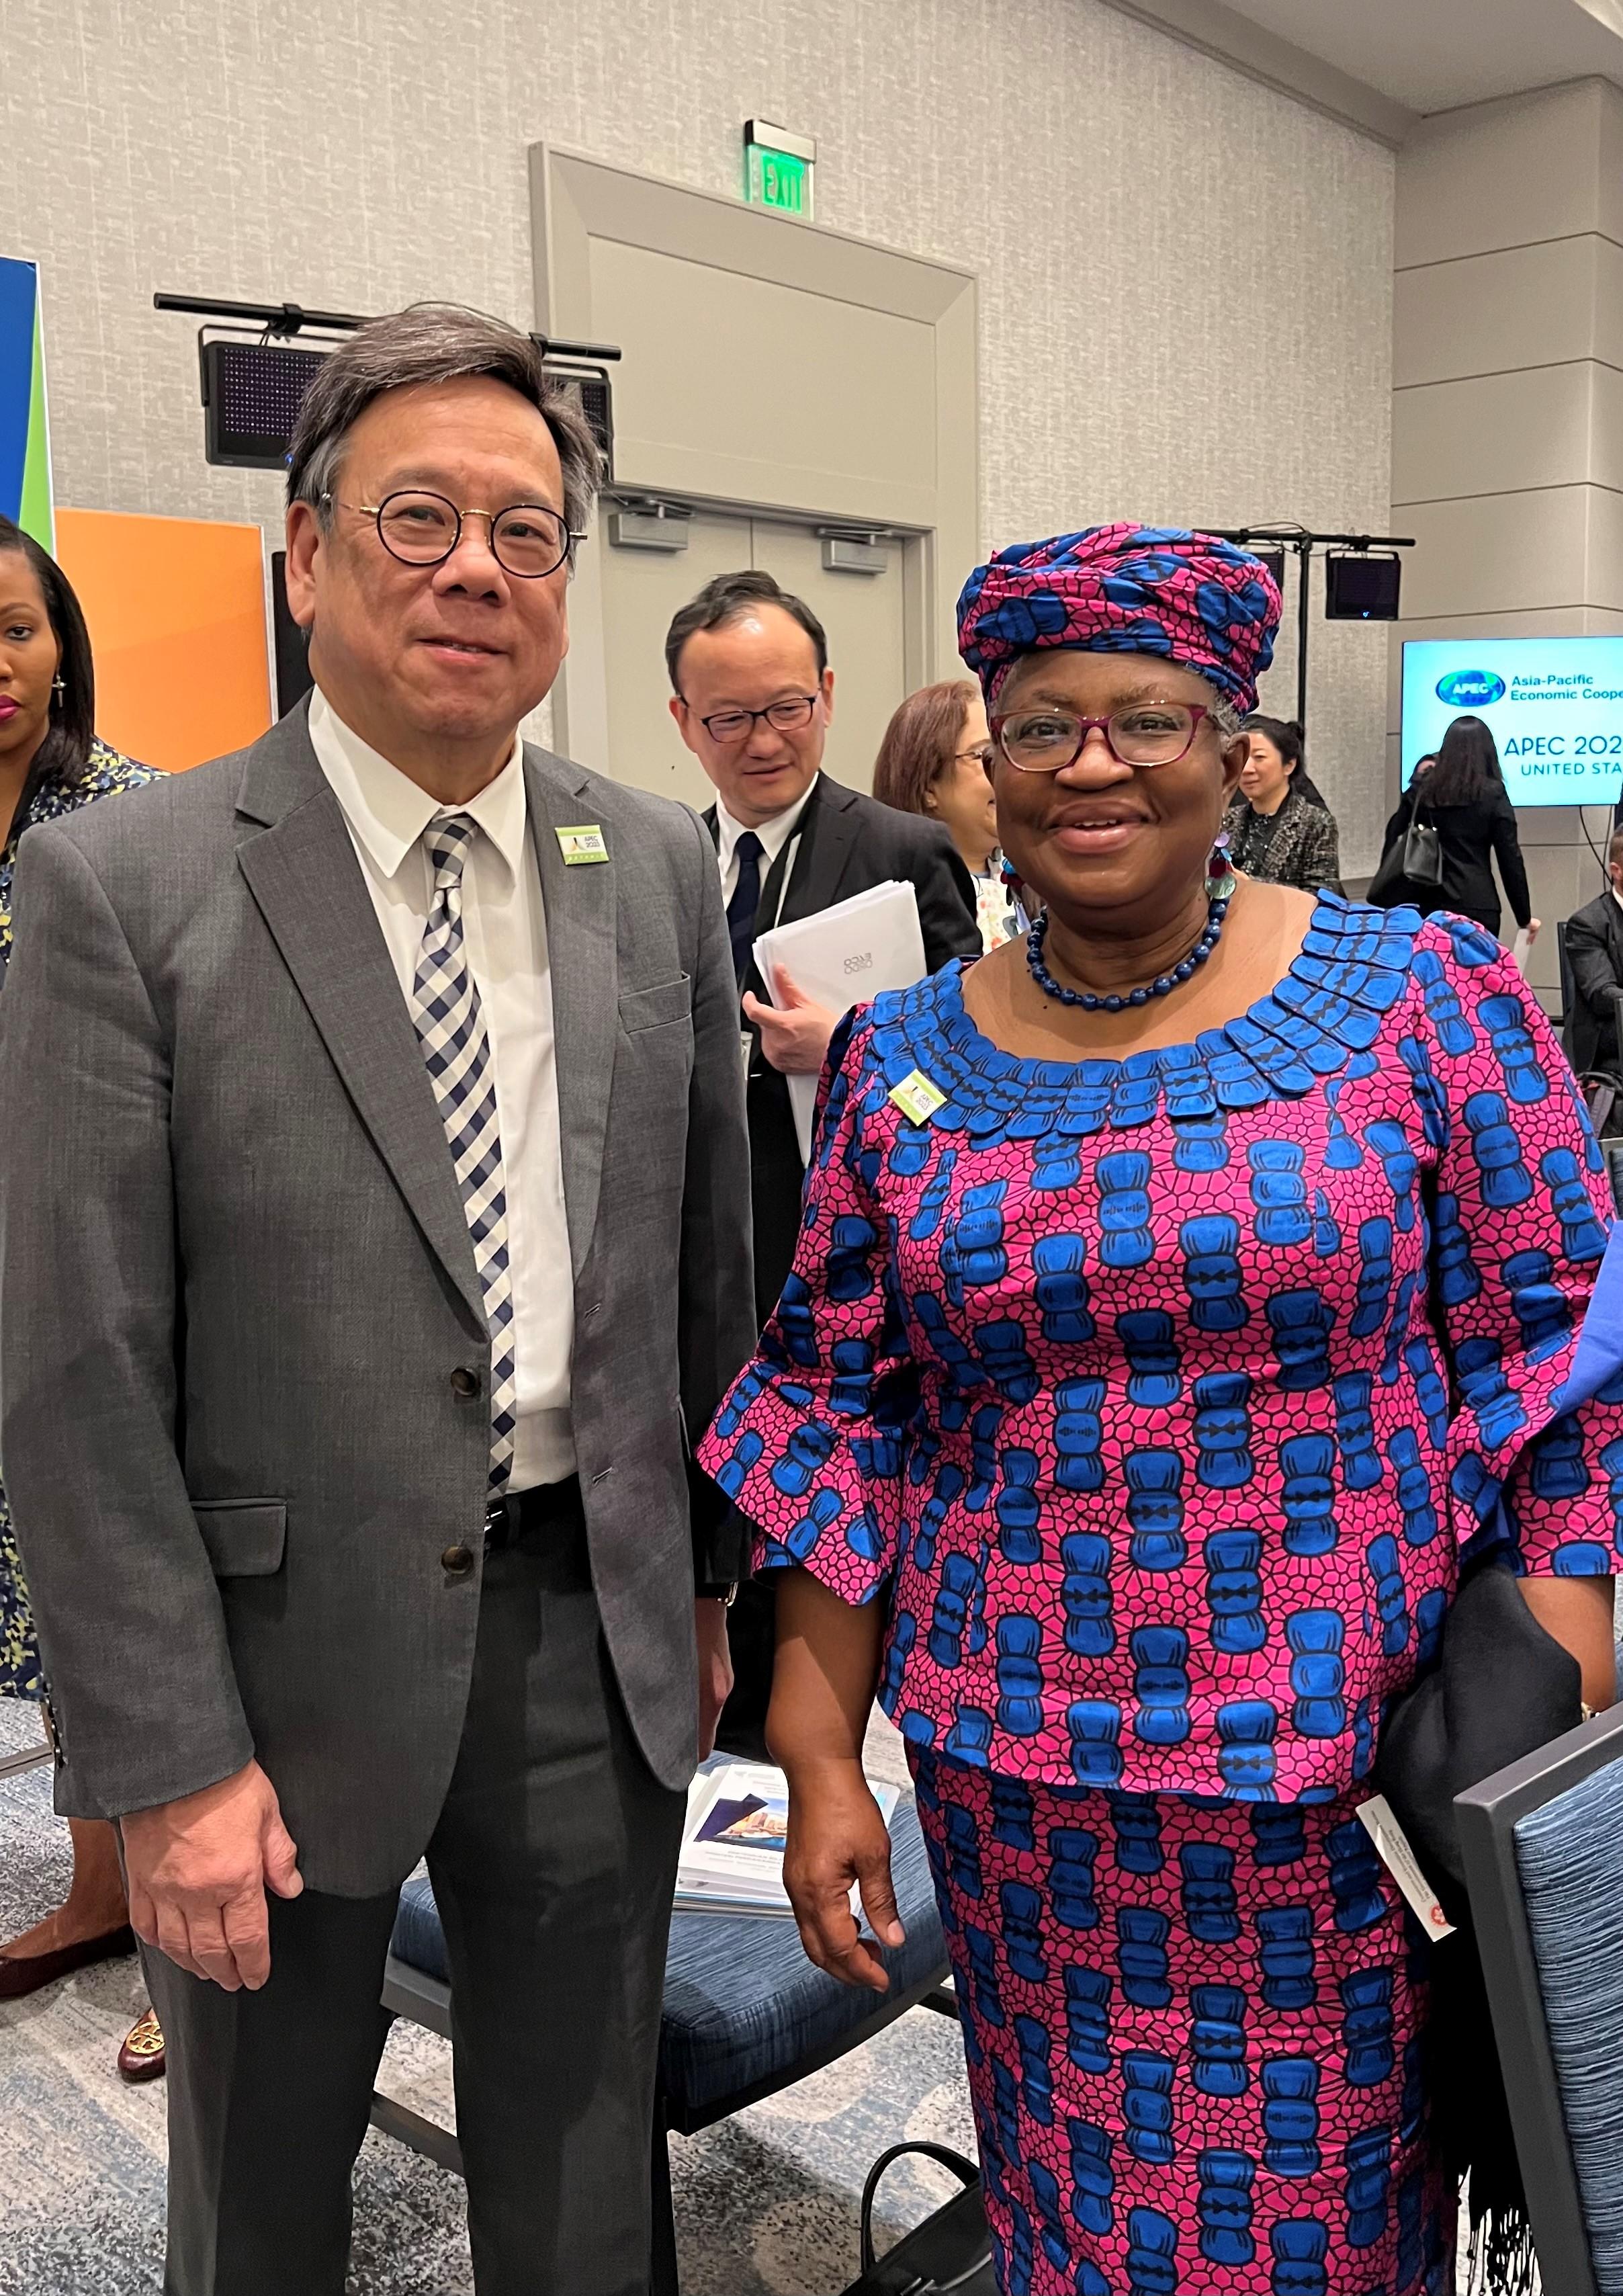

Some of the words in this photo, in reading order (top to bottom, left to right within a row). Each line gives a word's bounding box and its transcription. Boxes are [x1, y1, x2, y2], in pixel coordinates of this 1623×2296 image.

[763, 154, 804, 213] EXIT
[1511, 674, 1593, 686] Asia-Pacific
[1452, 683, 1489, 694] APEC
[1511, 689, 1577, 700] Economic
[1504, 736, 1565, 756] APEC
[1575, 735, 1622, 755] 202
[1521, 763, 1585, 775] UNITED
[1591, 762, 1622, 775] STA
